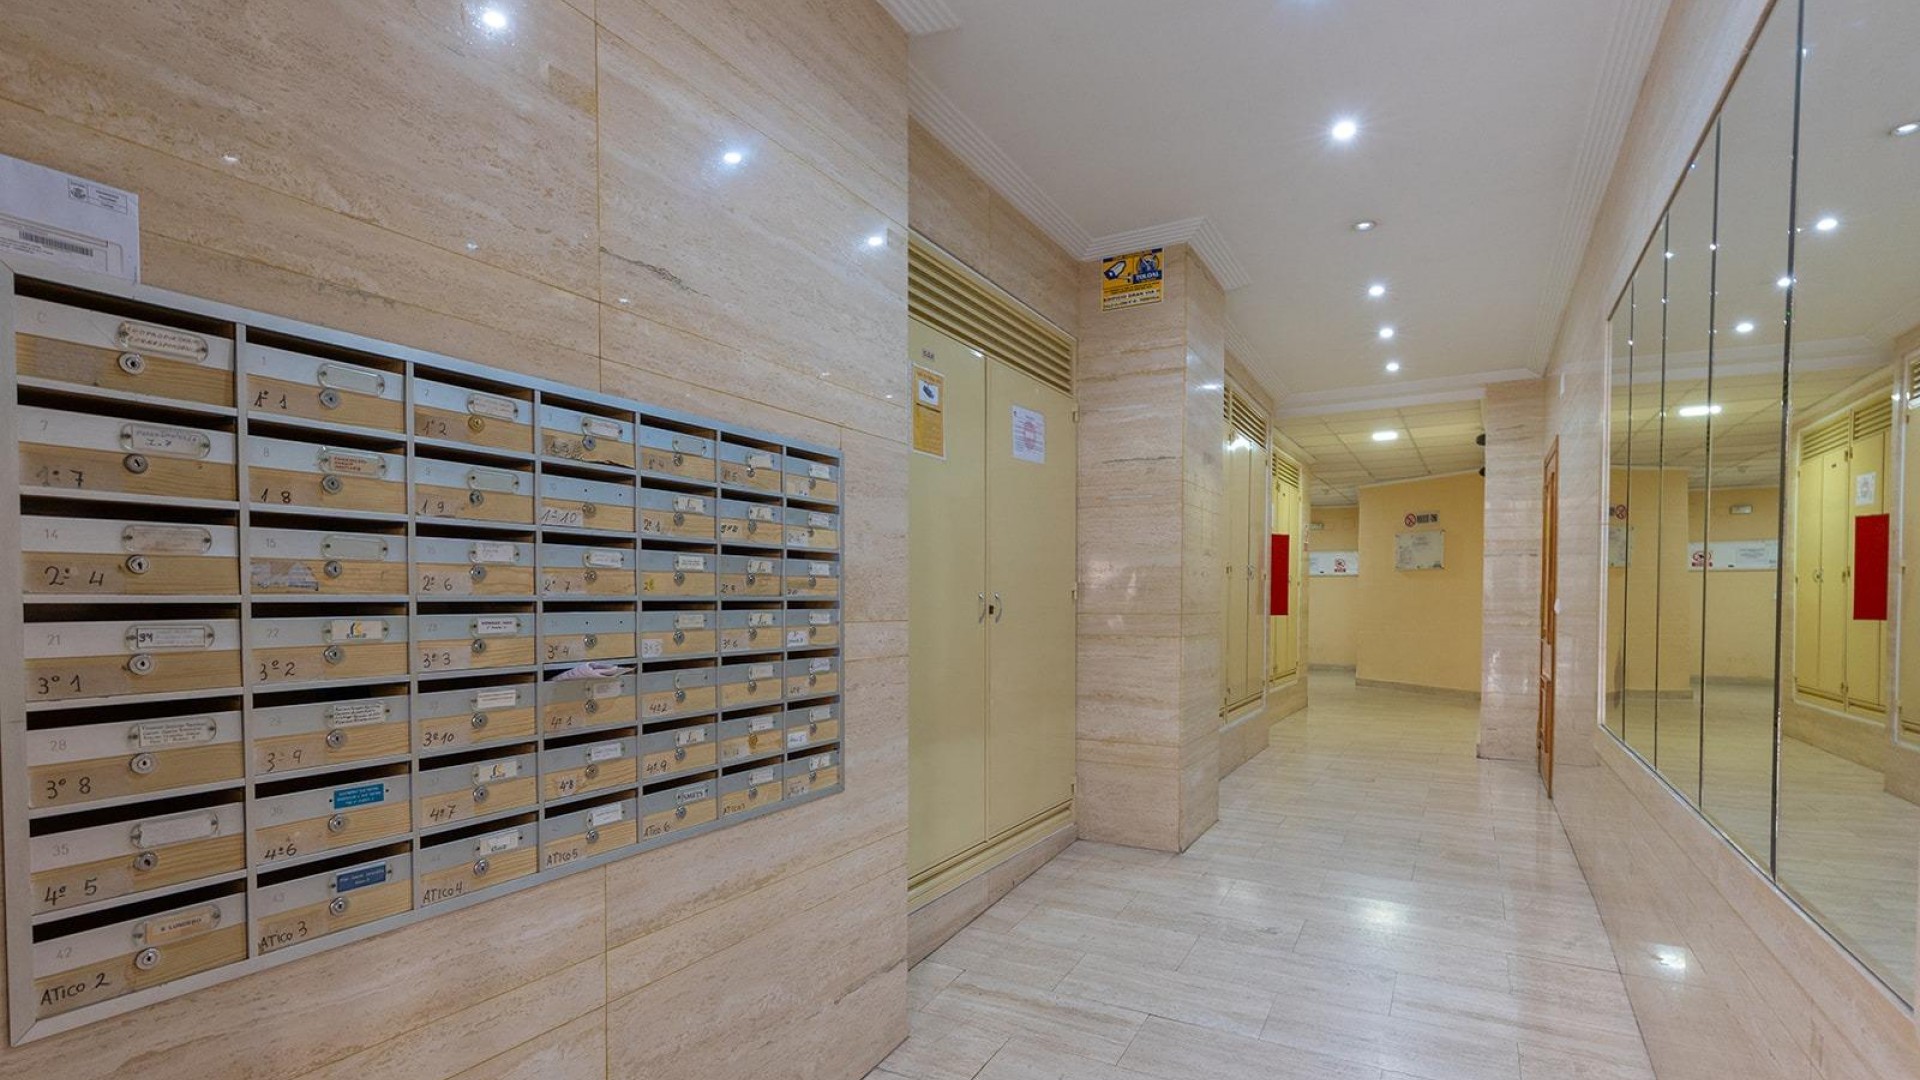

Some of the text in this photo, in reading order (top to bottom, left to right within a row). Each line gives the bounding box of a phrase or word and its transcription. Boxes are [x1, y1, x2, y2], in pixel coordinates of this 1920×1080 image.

[439, 422, 447, 436] 2
[69, 469, 84, 488] 7
[281, 490, 292, 504] 8
[437, 500, 445, 513] 9
[560, 512, 577, 523] 10
[88, 570, 104, 587] 4
[443, 577, 453, 592] 6
[564, 580, 571, 593] 7
[442, 651, 451, 666] 3
[284, 661, 296, 677] 2
[69, 674, 83, 693] 1
[50, 739, 67, 752] 28
[292, 750, 303, 764] 9
[78, 776, 92, 795] 8
[84, 876, 98, 896] 5
[455, 880, 464, 894] 4
[297, 920, 308, 937] 3
[94, 972, 111, 990] 2
